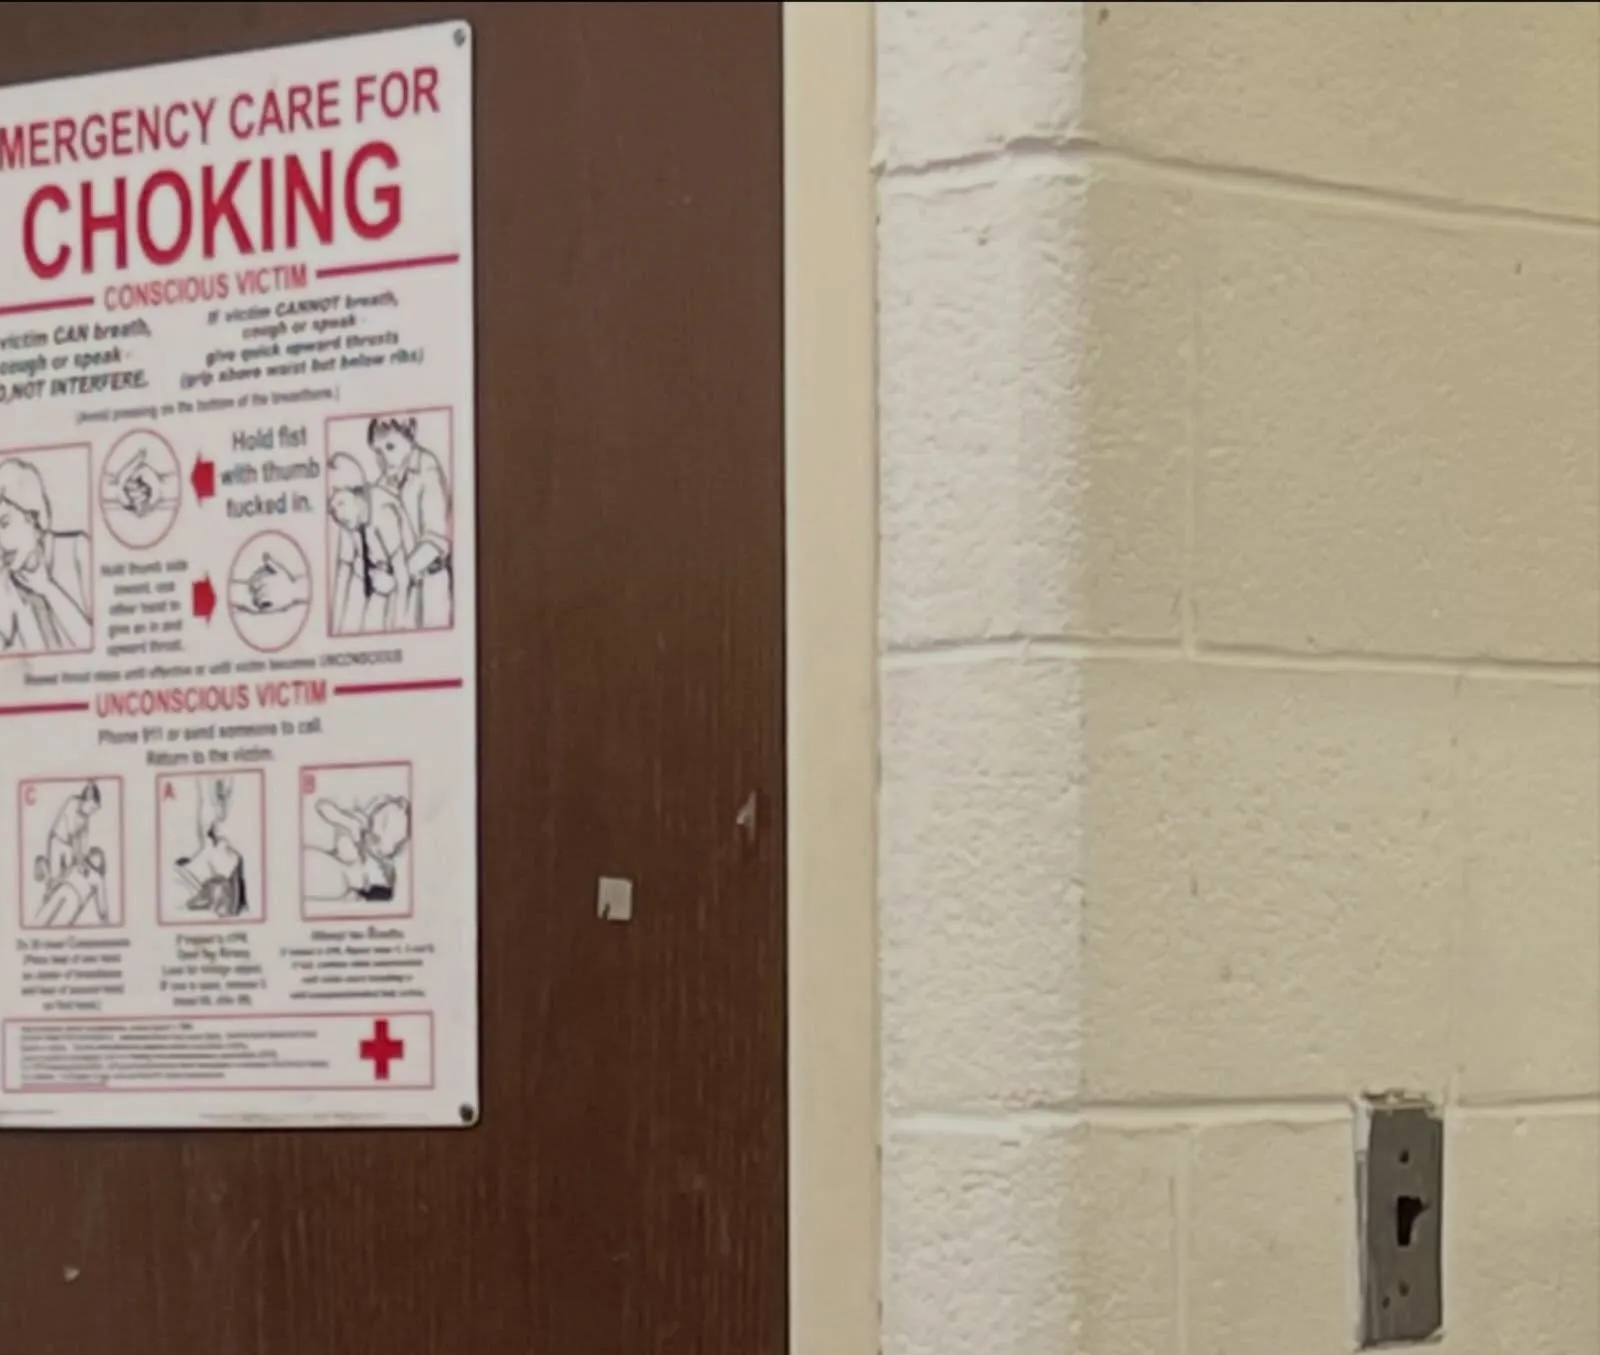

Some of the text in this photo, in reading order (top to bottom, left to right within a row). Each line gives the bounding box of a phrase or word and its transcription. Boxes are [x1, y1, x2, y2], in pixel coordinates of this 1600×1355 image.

[230, 81, 340, 140] CARE
[356, 67, 440, 123] FOR
[22, 141, 402, 280] CHOKING
[104, 263, 307, 311] CONSCIOUS VICTIM
[208, 290, 399, 325] If victim CANNOT breath,
[0, 332, 48, 350] victim
[53, 325, 89, 345] CAN
[94, 318, 152, 340] breath,
[242, 314, 356, 340] cough or speak
[0, 347, 121, 376] cough or speak
[206, 331, 399, 367] give quick upward thrusts
[181, 347, 425, 389] (grip above waist but below ribs)
[9, 379, 45, 403] NOT
[50, 369, 150, 397] INTERFERE.
[232, 425, 307, 450] Hold fist
[222, 456, 320, 485] with thumb
[226, 492, 313, 518] tucked in.
[95, 679, 328, 719] UNCONSCIOUS VICTIM
[98, 717, 323, 745] Phone 911 or send someone to call.
[147, 746, 274, 765] Return to the victim.
[163, 781, 175, 800] A
